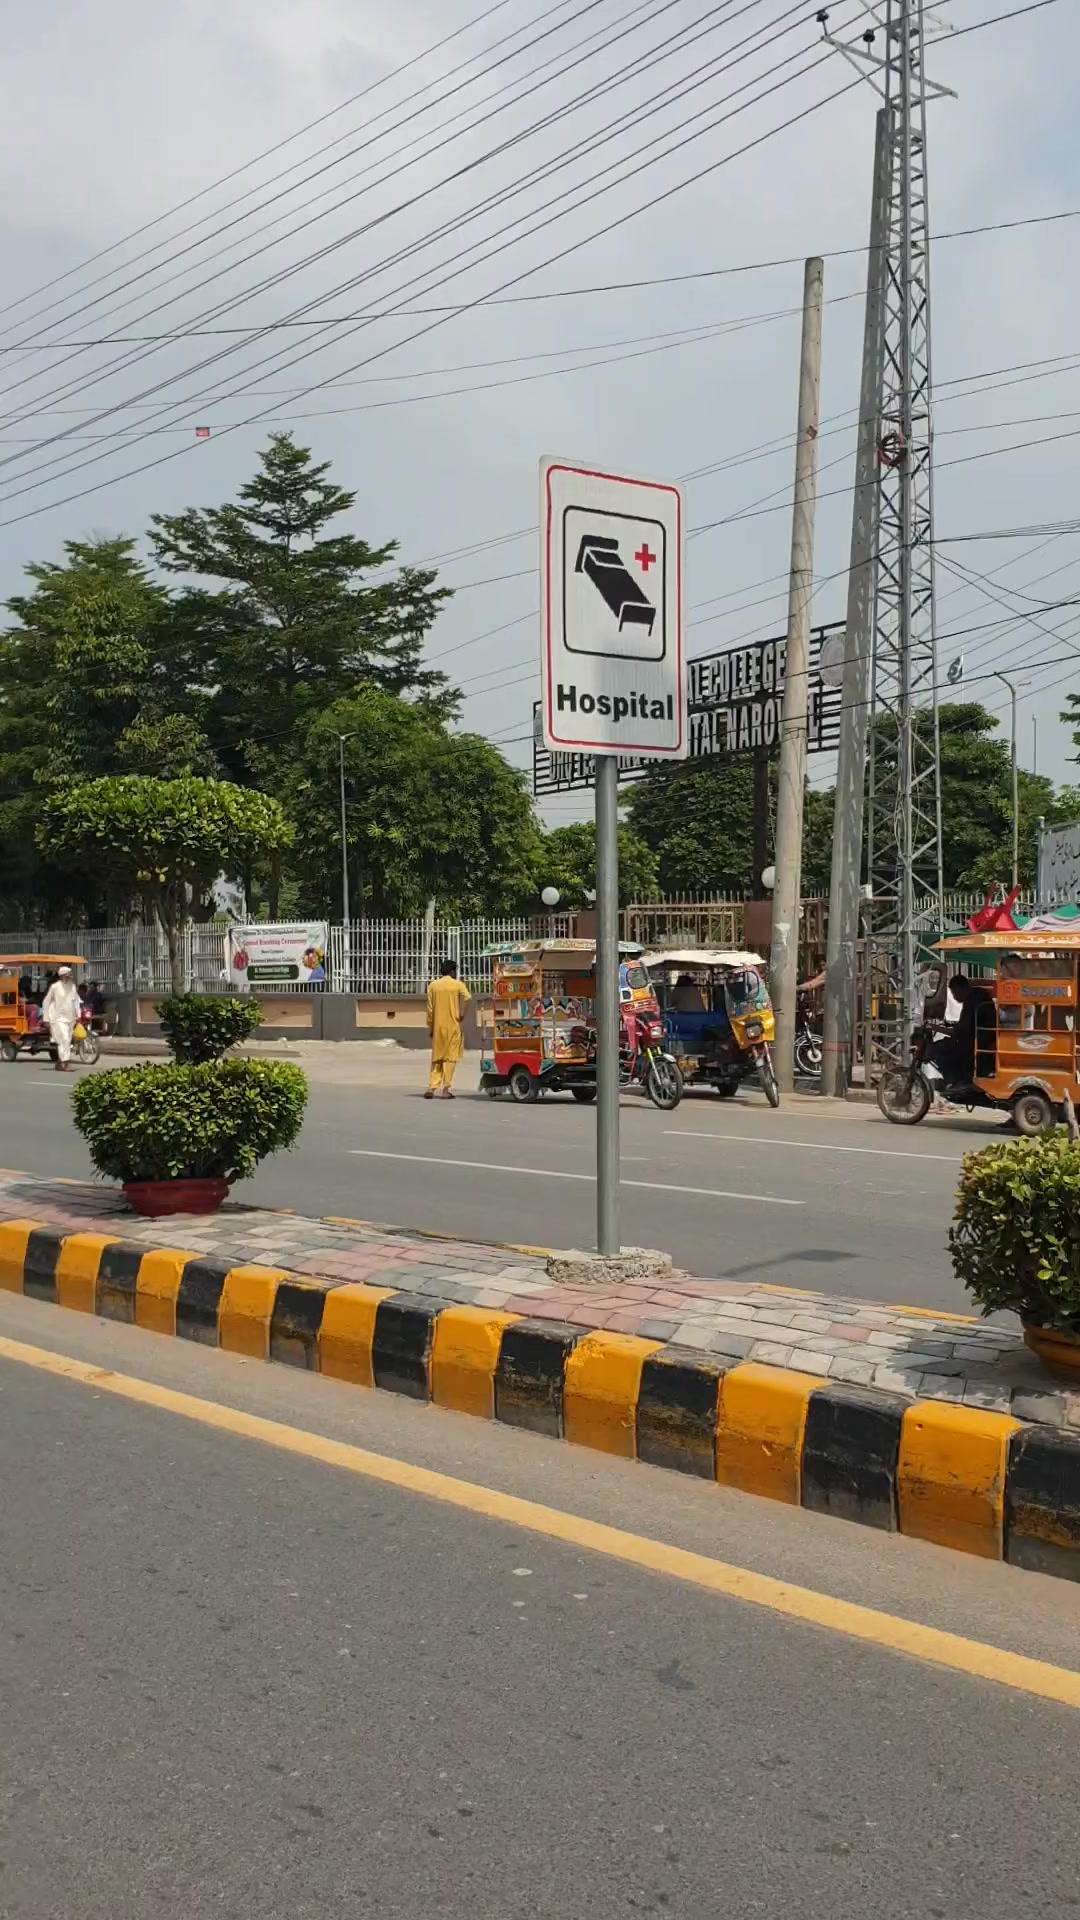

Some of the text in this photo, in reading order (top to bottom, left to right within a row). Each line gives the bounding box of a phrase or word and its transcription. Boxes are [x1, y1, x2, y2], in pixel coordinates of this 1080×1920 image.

[708, 642, 787, 698] COLLEGE
[557, 684, 673, 722] Hospital
[1020, 985, 1072, 997] SUZUKI
